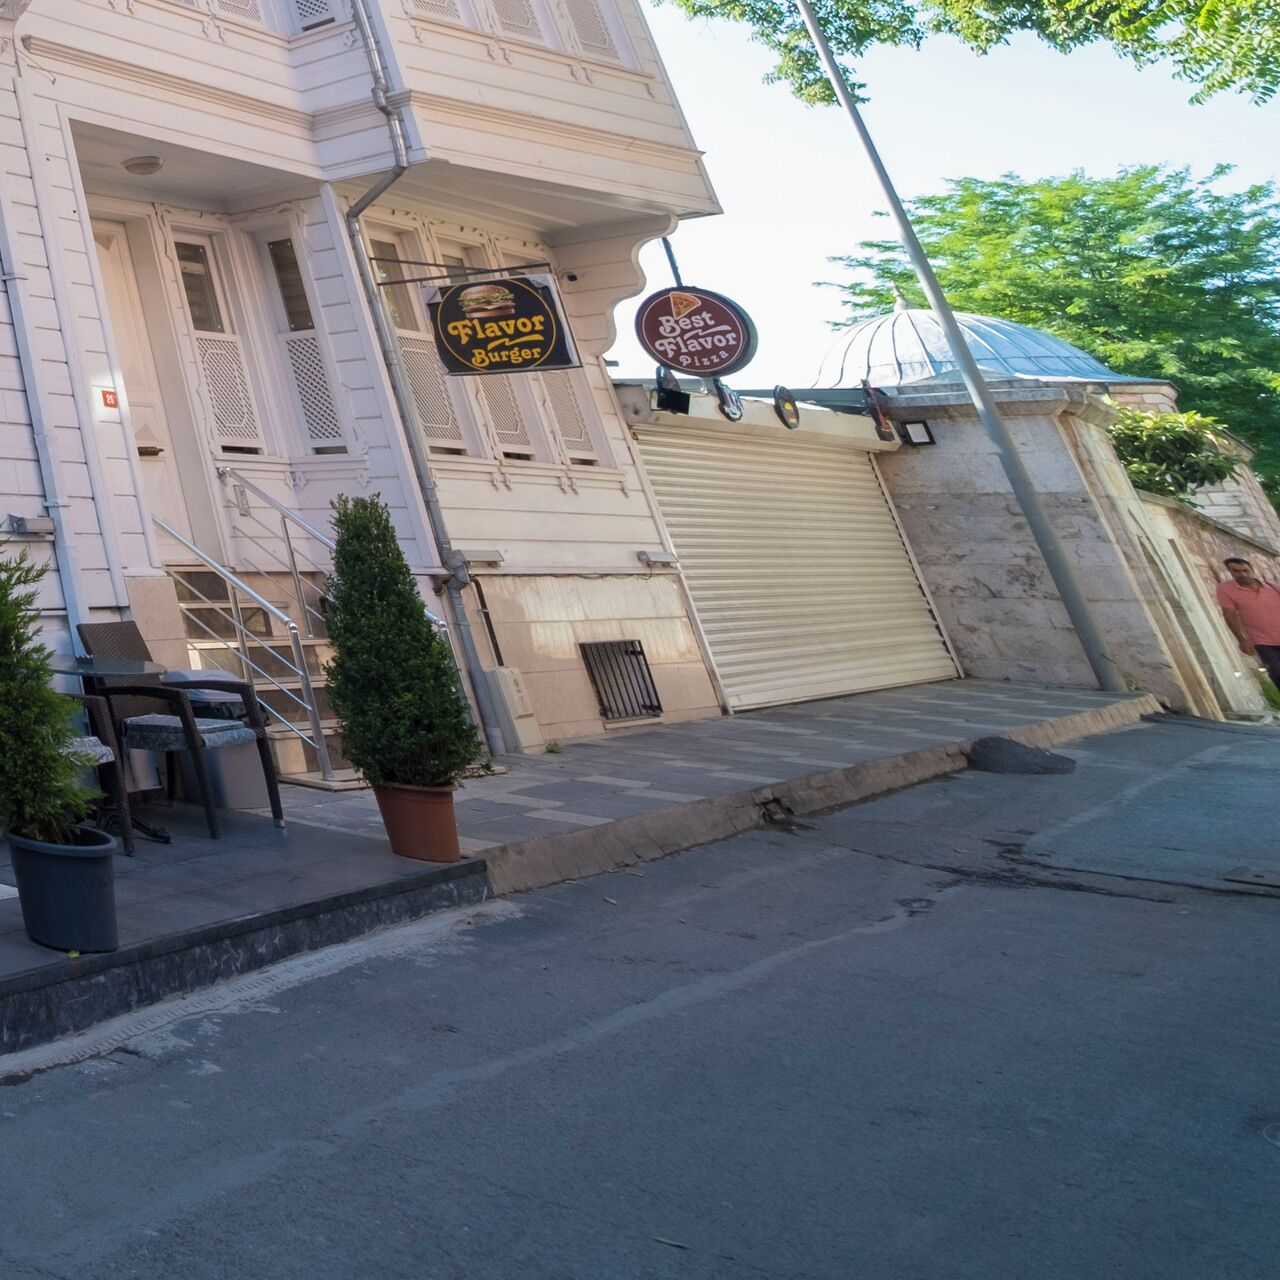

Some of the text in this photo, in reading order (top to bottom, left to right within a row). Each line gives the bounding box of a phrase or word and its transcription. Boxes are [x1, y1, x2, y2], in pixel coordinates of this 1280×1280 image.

[447, 313, 545, 345] Flavor
[659, 310, 716, 338] Best
[472, 346, 541, 368] Burger
[655, 330, 737, 358] Flavor
[679, 350, 729, 368] Pizza
